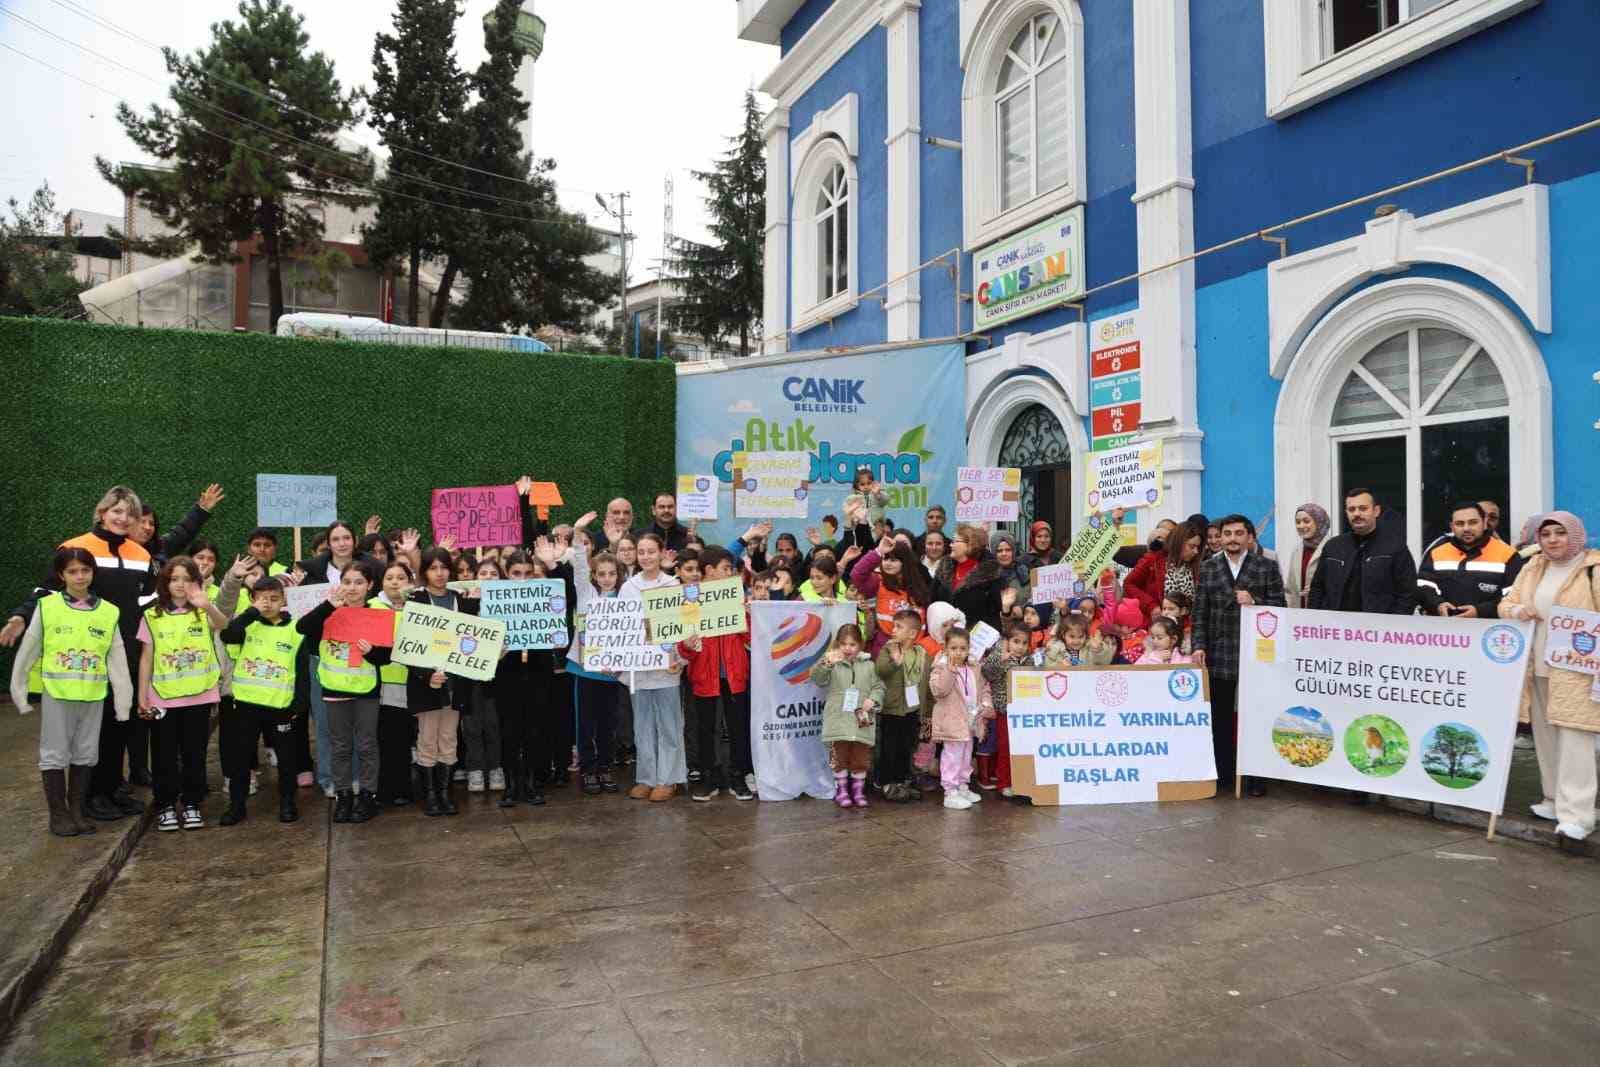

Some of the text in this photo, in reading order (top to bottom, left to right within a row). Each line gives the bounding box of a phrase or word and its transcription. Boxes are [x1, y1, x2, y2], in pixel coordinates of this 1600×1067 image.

[978, 249, 1068, 305] CANSAM
[794, 402, 858, 413] BELEDİYESİ
[1100, 463, 1140, 478] YARINLAR
[1098, 471, 1155, 488] OKULLARDAN
[1102, 486, 1134, 500] BAŞLAR
[486, 584, 552, 600] TERTEMİZ
[486, 602, 551, 615] YARINLAR
[648, 592, 689, 611] TEMİZ
[408, 611, 499, 642] TEMİZ ÇEVRE
[657, 615, 739, 639] İÇİN EL ELE
[503, 634, 553, 647] BAŞLAR
[589, 632, 646, 648] TEMİZL
[1293, 625, 1341, 642] ŞERİFE
[1344, 628, 1379, 644] BACI
[1383, 630, 1471, 648] ANAOKULU
[398, 637, 428, 655] İÇİN
[448, 652, 463, 665] EL
[465, 656, 489, 671] ELE
[588, 651, 664, 667] GÖRÜLÜR
[1296, 658, 1467, 686] TEMİZ BİR ÇEVREYLE
[1295, 676, 1467, 708] GÜLÜMSE GELECEĞE
[1009, 709, 1209, 728] TERTEMİZ YARINLAR
[1038, 742, 1169, 758] OKULLARDAN
[1063, 768, 1140, 786] BAŞLAR
